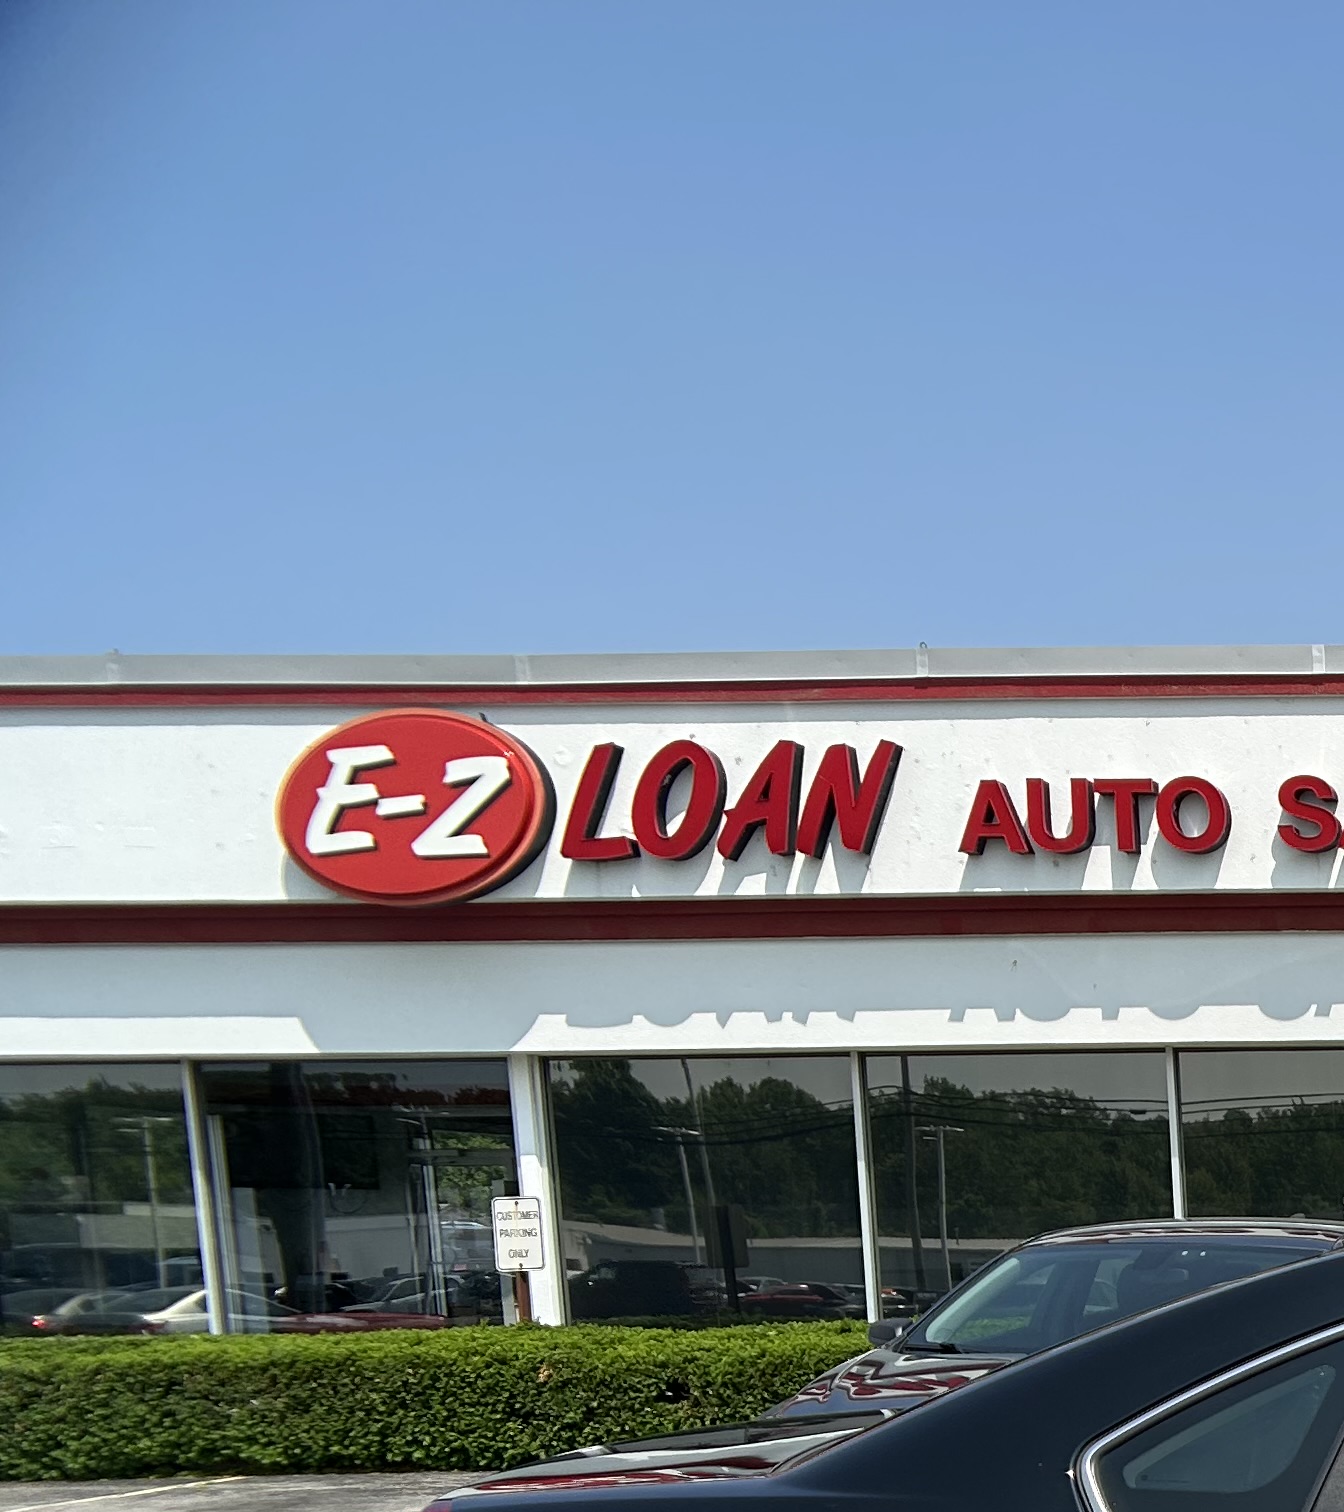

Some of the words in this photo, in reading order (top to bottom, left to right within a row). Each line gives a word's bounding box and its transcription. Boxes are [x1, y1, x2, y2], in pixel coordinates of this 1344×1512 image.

[304, 744, 513, 858] E-Z
[561, 739, 903, 862] LOAN
[958, 775, 1231, 856] AUTO
[496, 1210, 539, 1220] CUSTOMER
[499, 1228, 537, 1237] PARKING
[508, 1249, 529, 1258] ONLY
